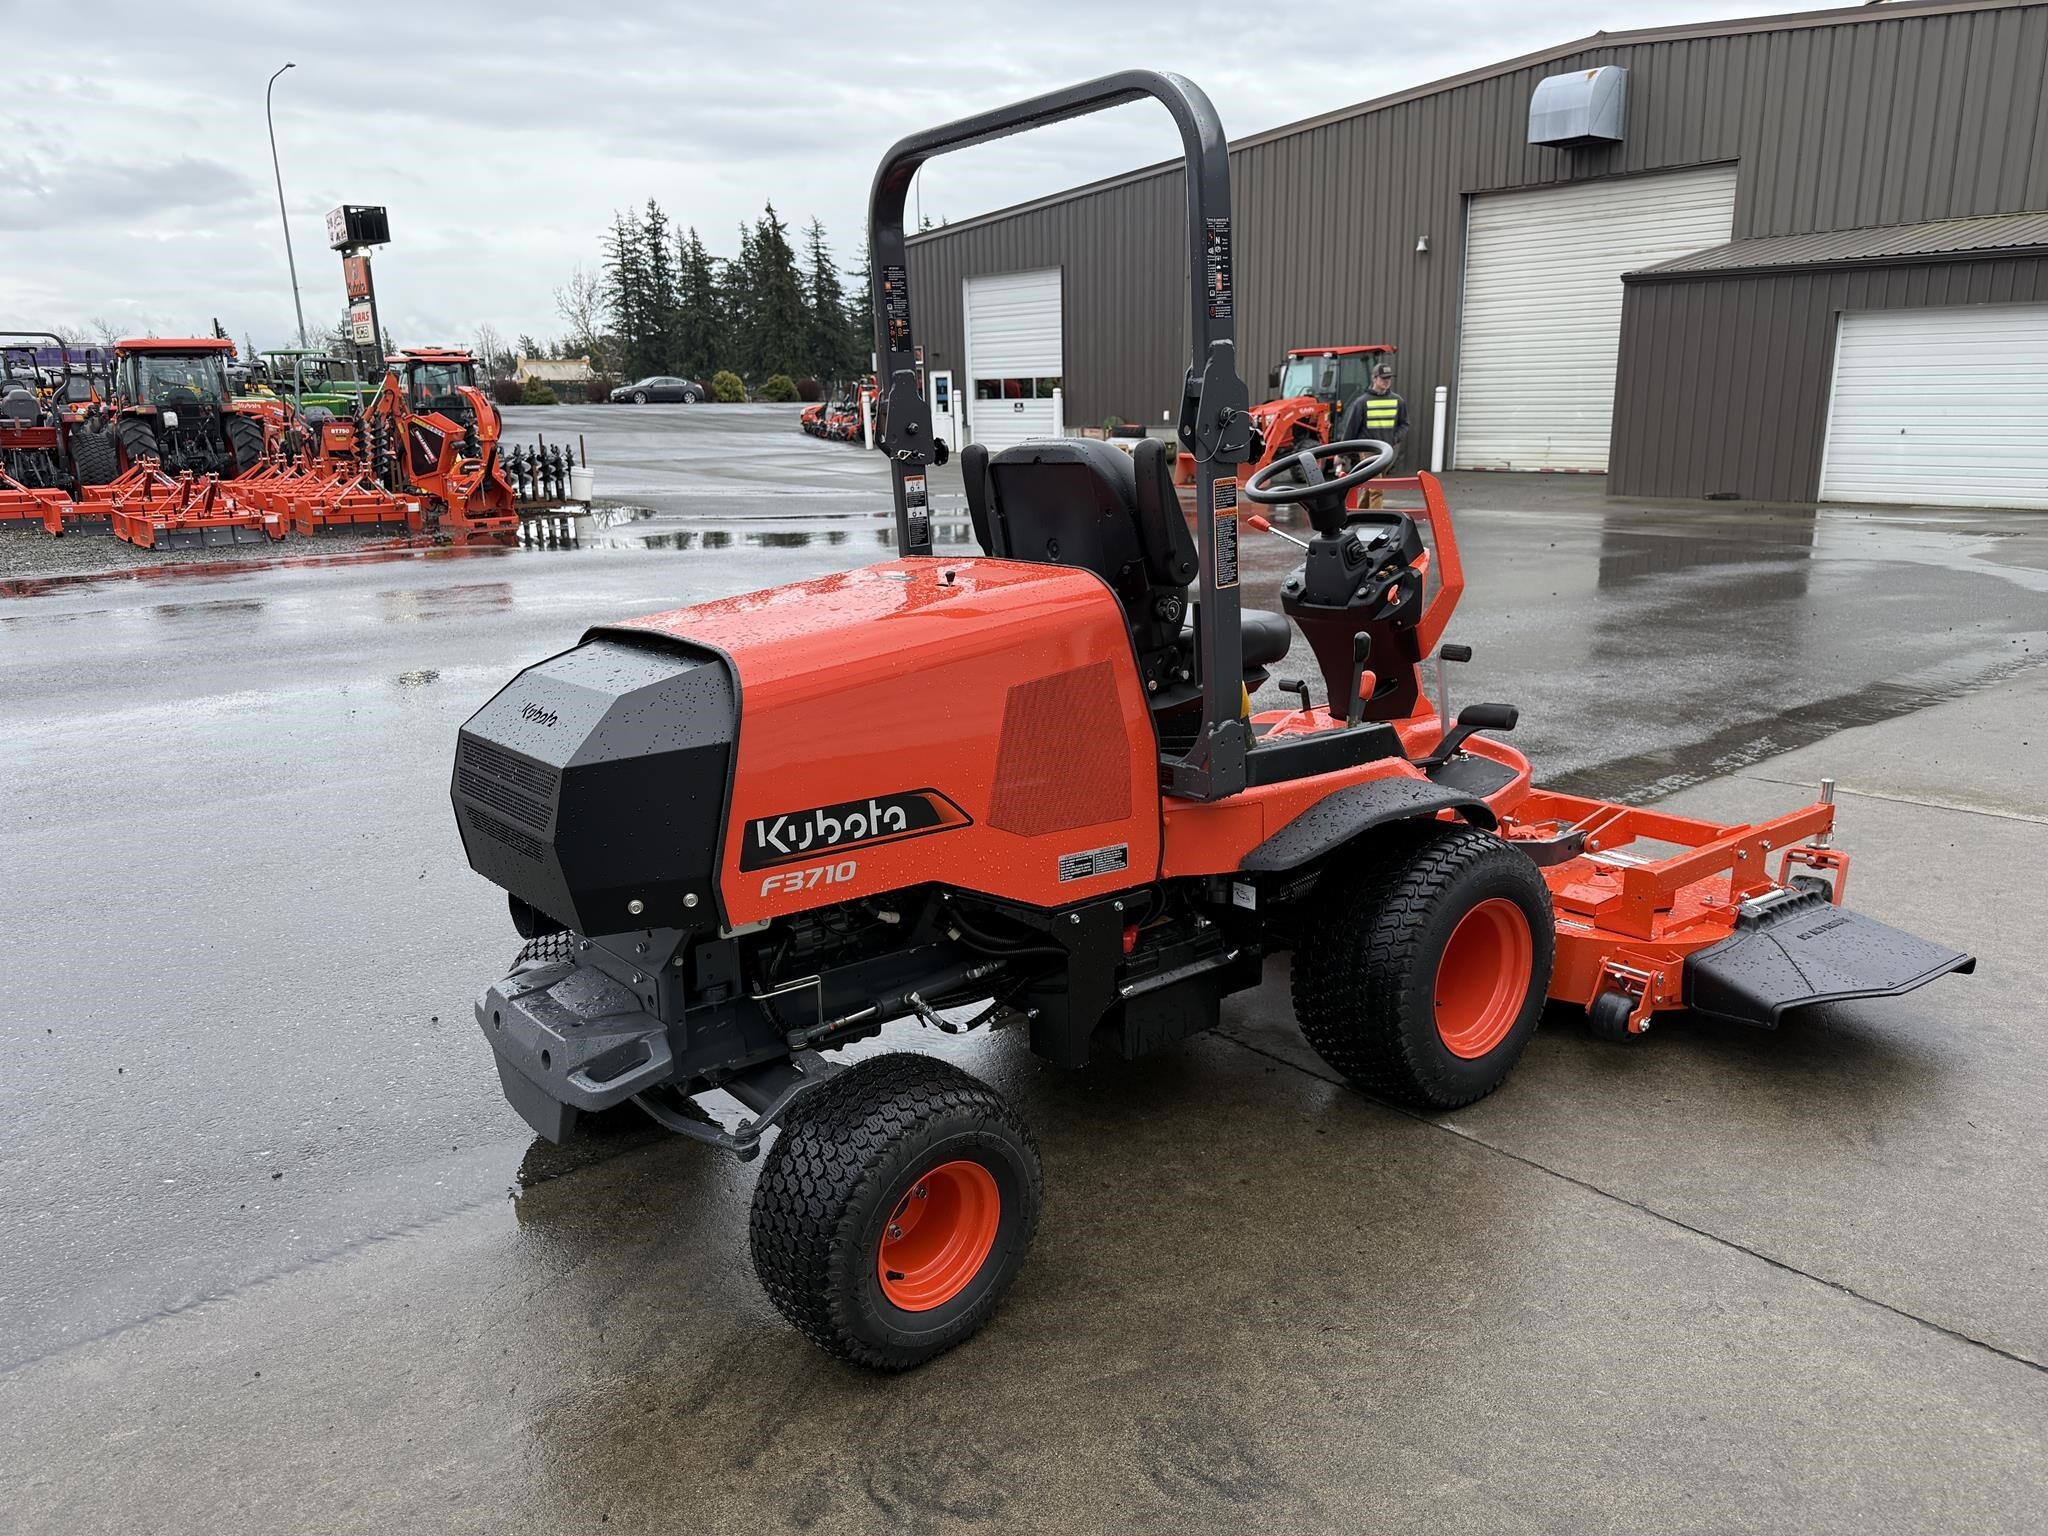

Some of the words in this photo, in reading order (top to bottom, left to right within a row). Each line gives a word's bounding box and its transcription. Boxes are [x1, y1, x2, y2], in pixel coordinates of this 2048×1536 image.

[351, 311, 370, 324] CLAAS
[356, 326, 370, 338] JCB
[521, 702, 559, 727] Kubota
[756, 799, 907, 854] Kubota
[760, 861, 857, 897] F3710
